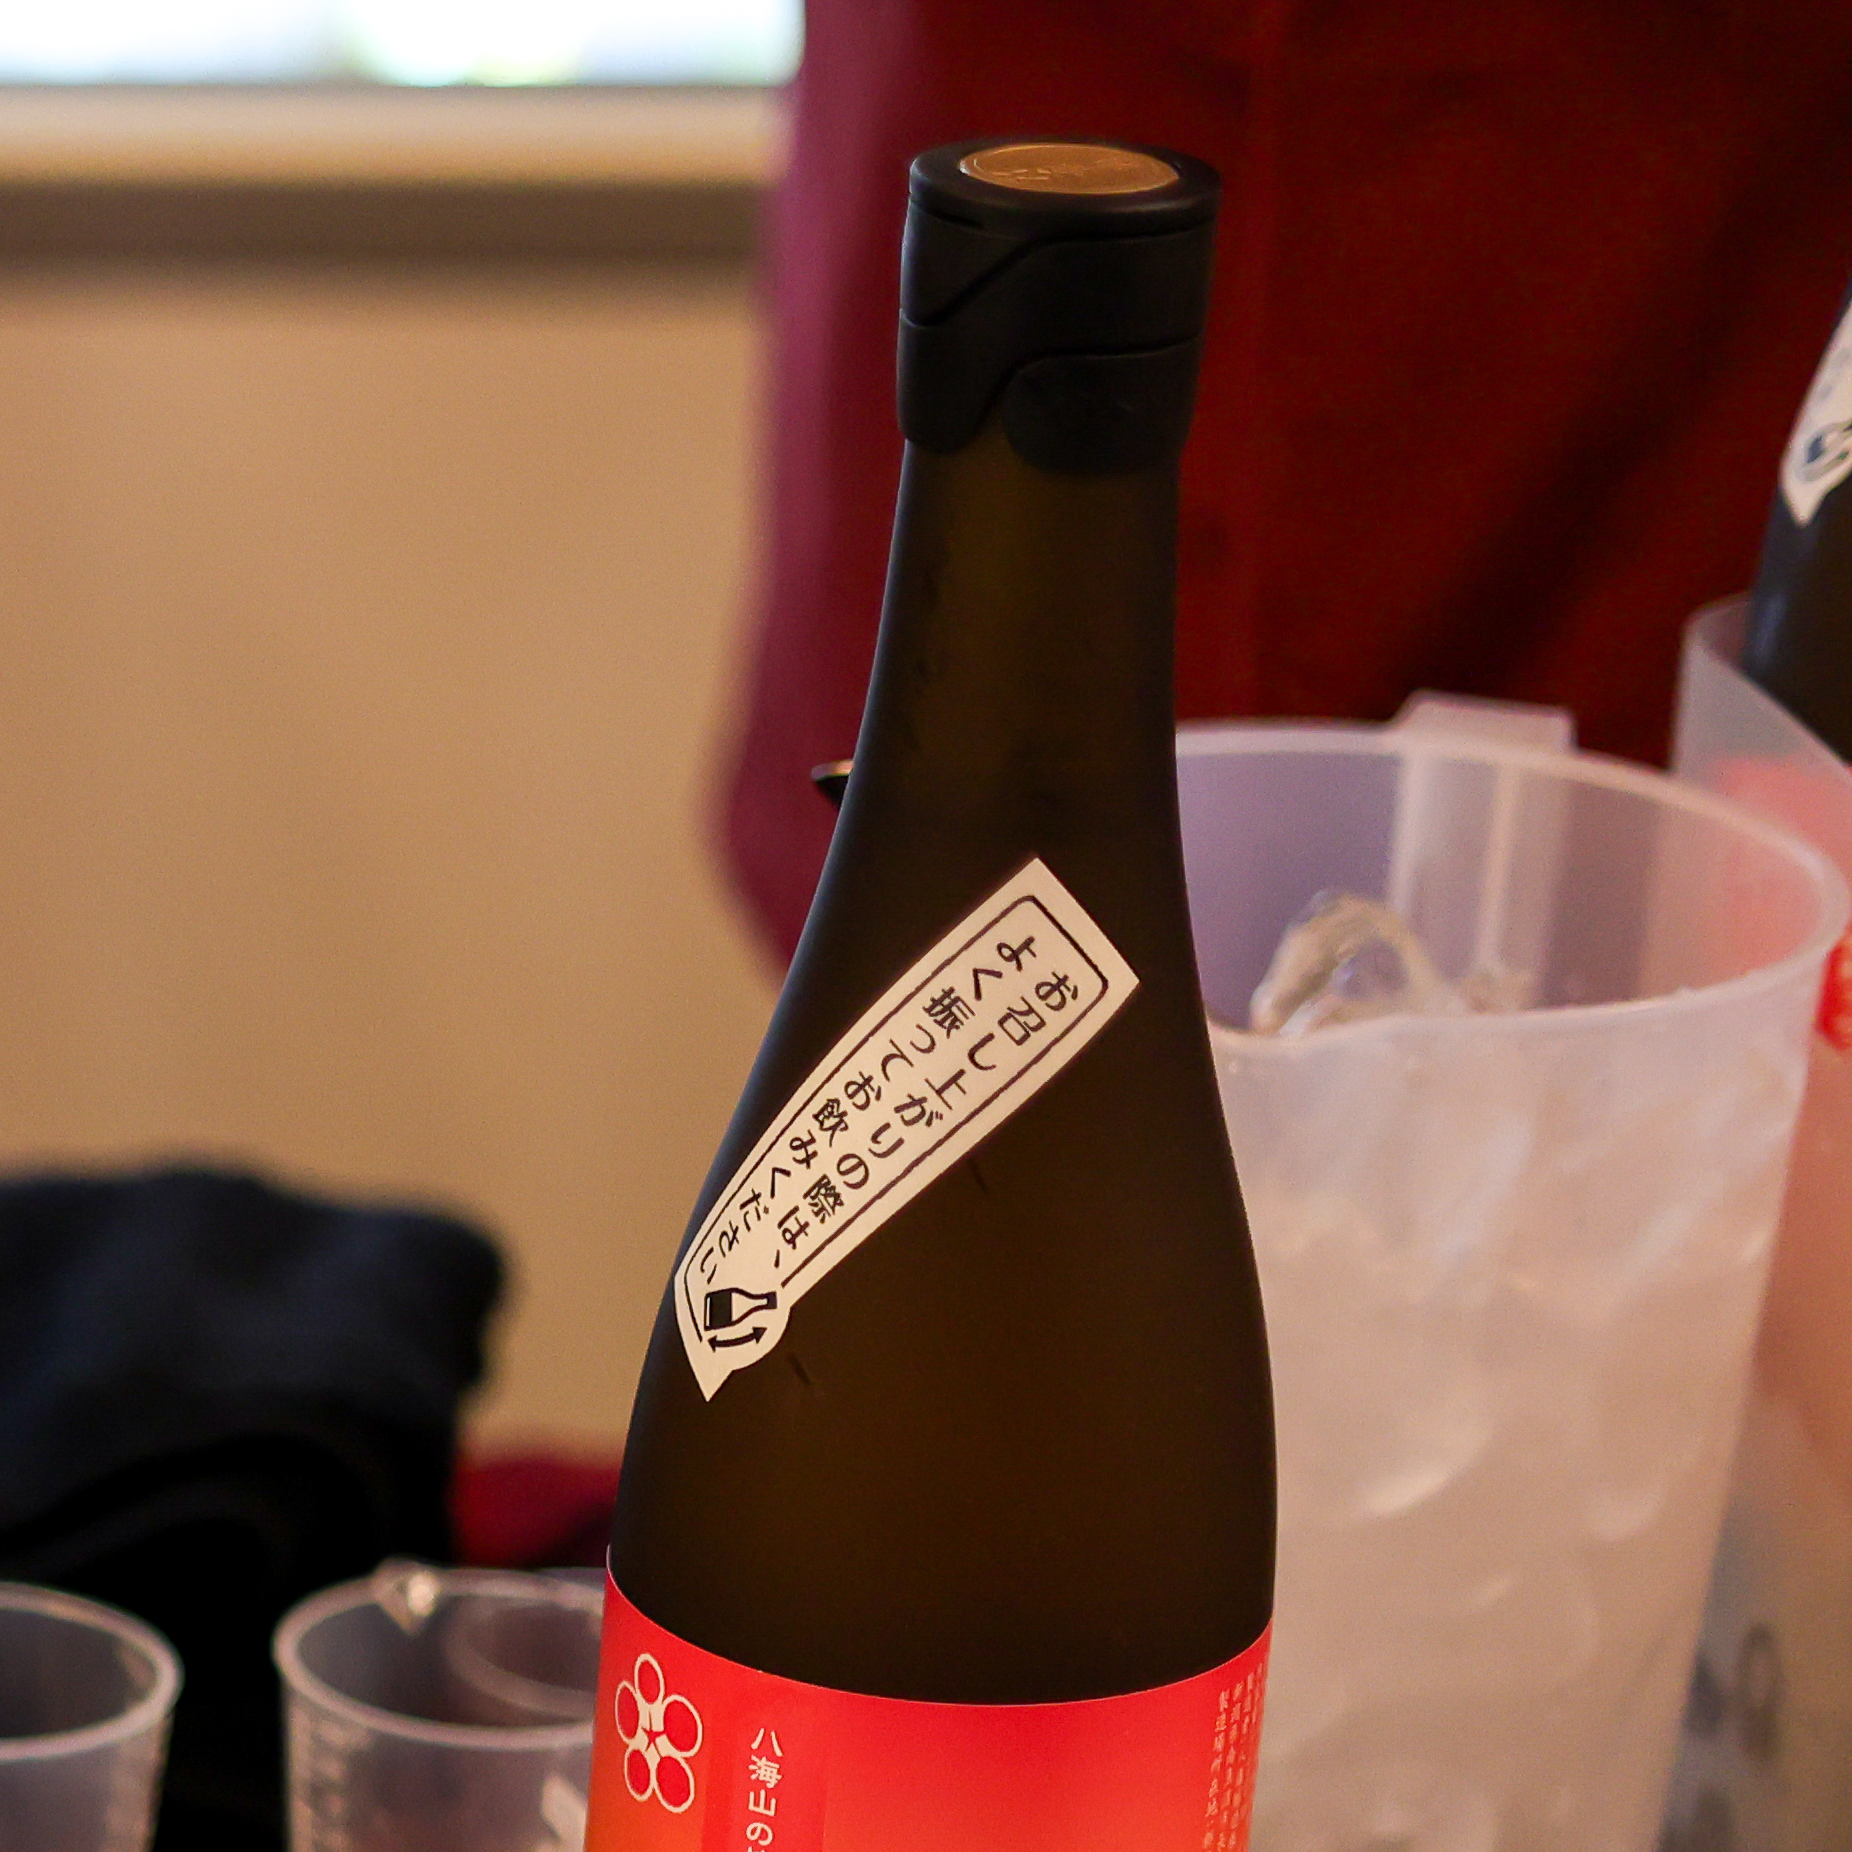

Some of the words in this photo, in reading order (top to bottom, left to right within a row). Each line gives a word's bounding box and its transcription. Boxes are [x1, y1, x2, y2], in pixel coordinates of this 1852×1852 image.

[700, 935, 1039, 1285] よく振ってお飲みください
[774, 970, 1080, 1268] お召し上がりの際は、
